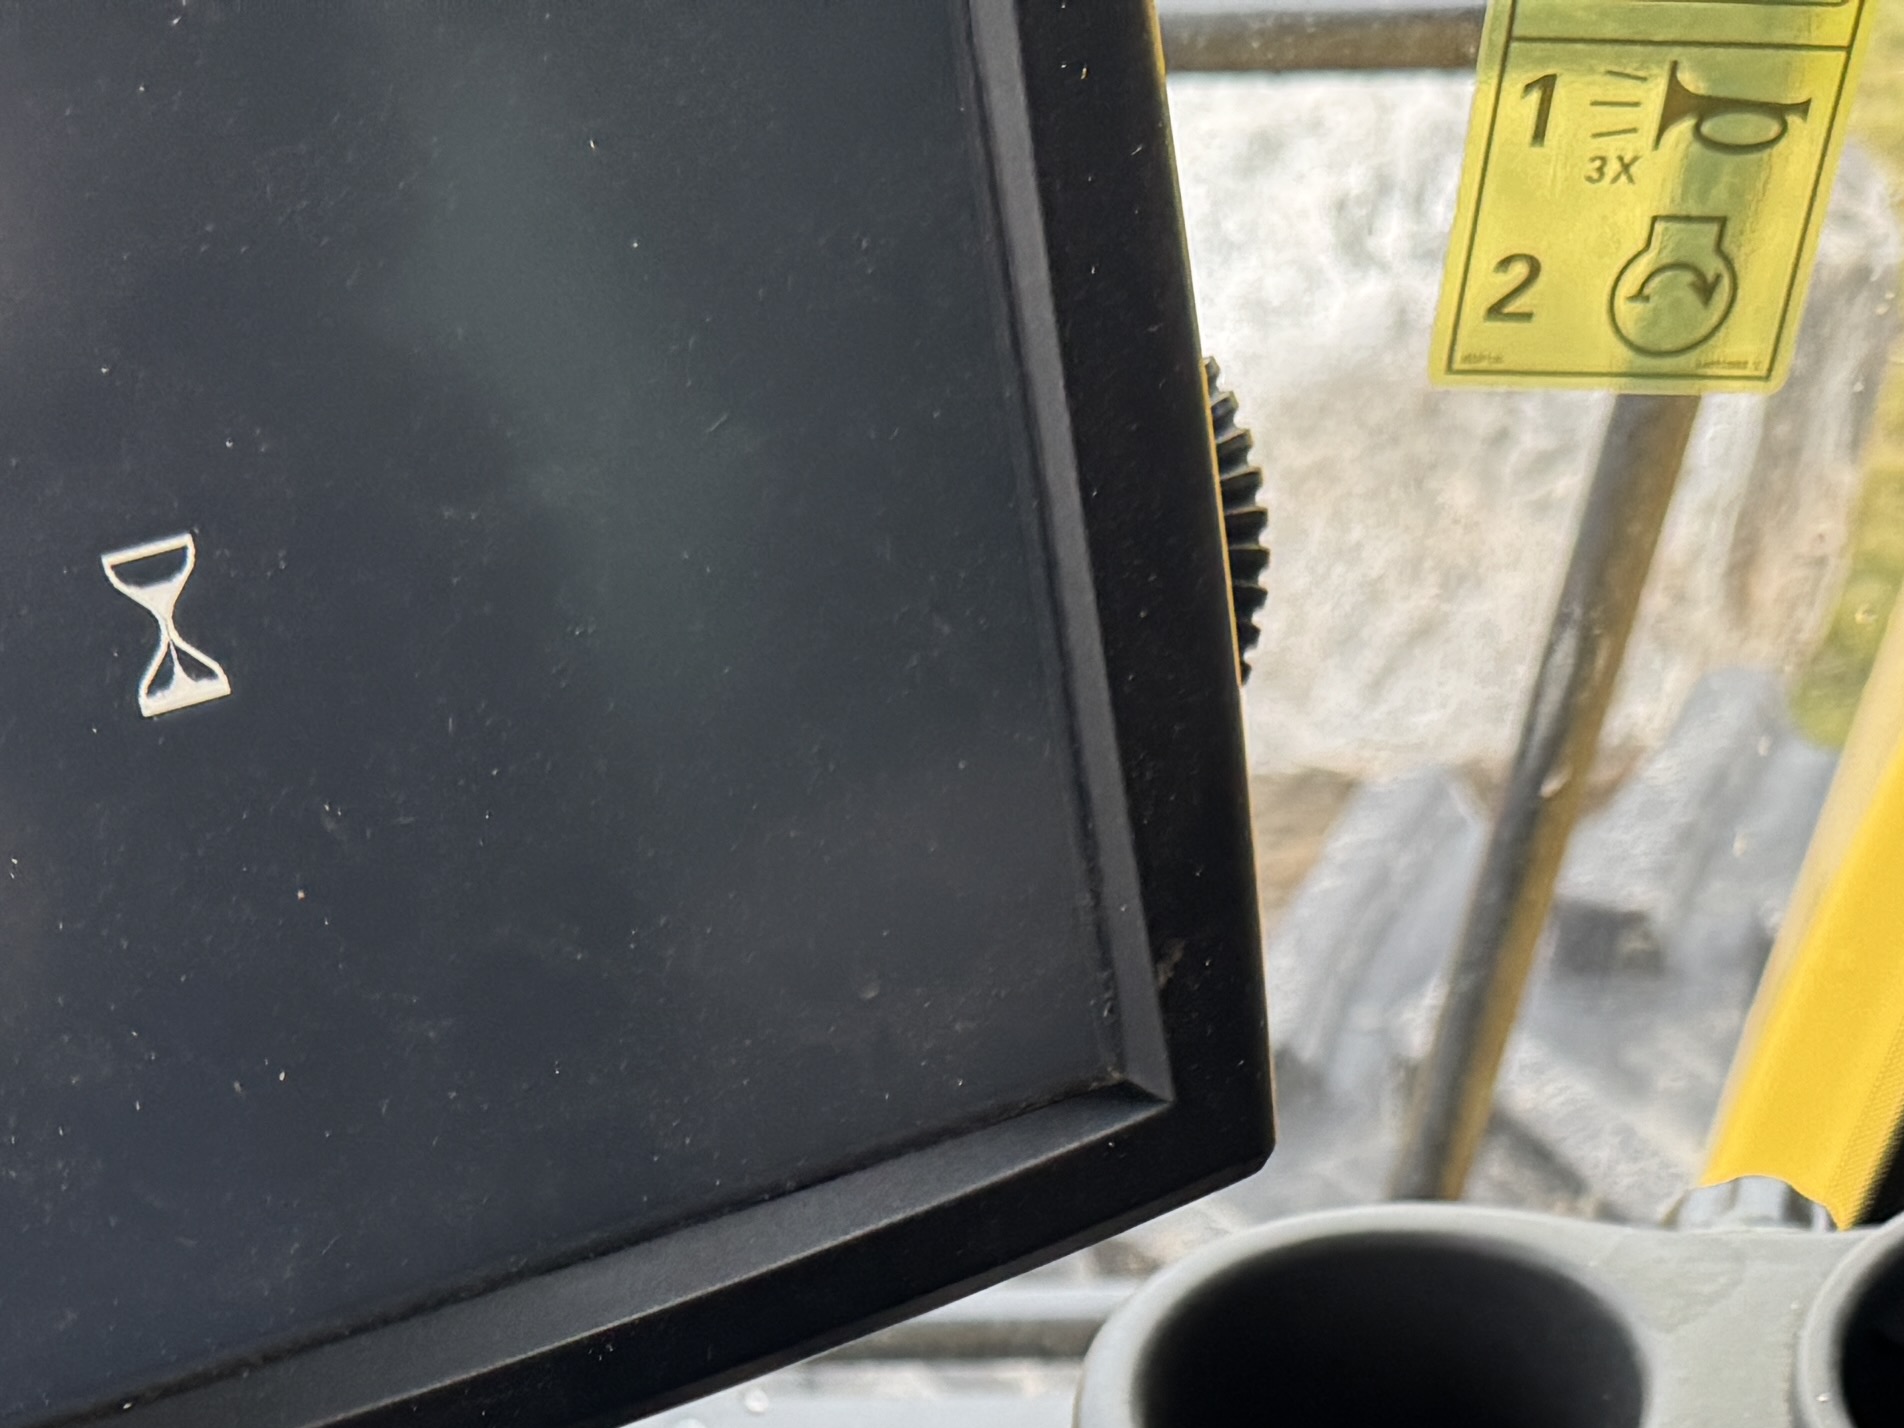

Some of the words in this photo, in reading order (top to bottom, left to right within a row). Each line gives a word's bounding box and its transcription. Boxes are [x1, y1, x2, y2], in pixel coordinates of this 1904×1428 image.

[1521, 72, 1558, 147] 1
[1583, 154, 1641, 186] 3X
[1483, 252, 1542, 324] 2
